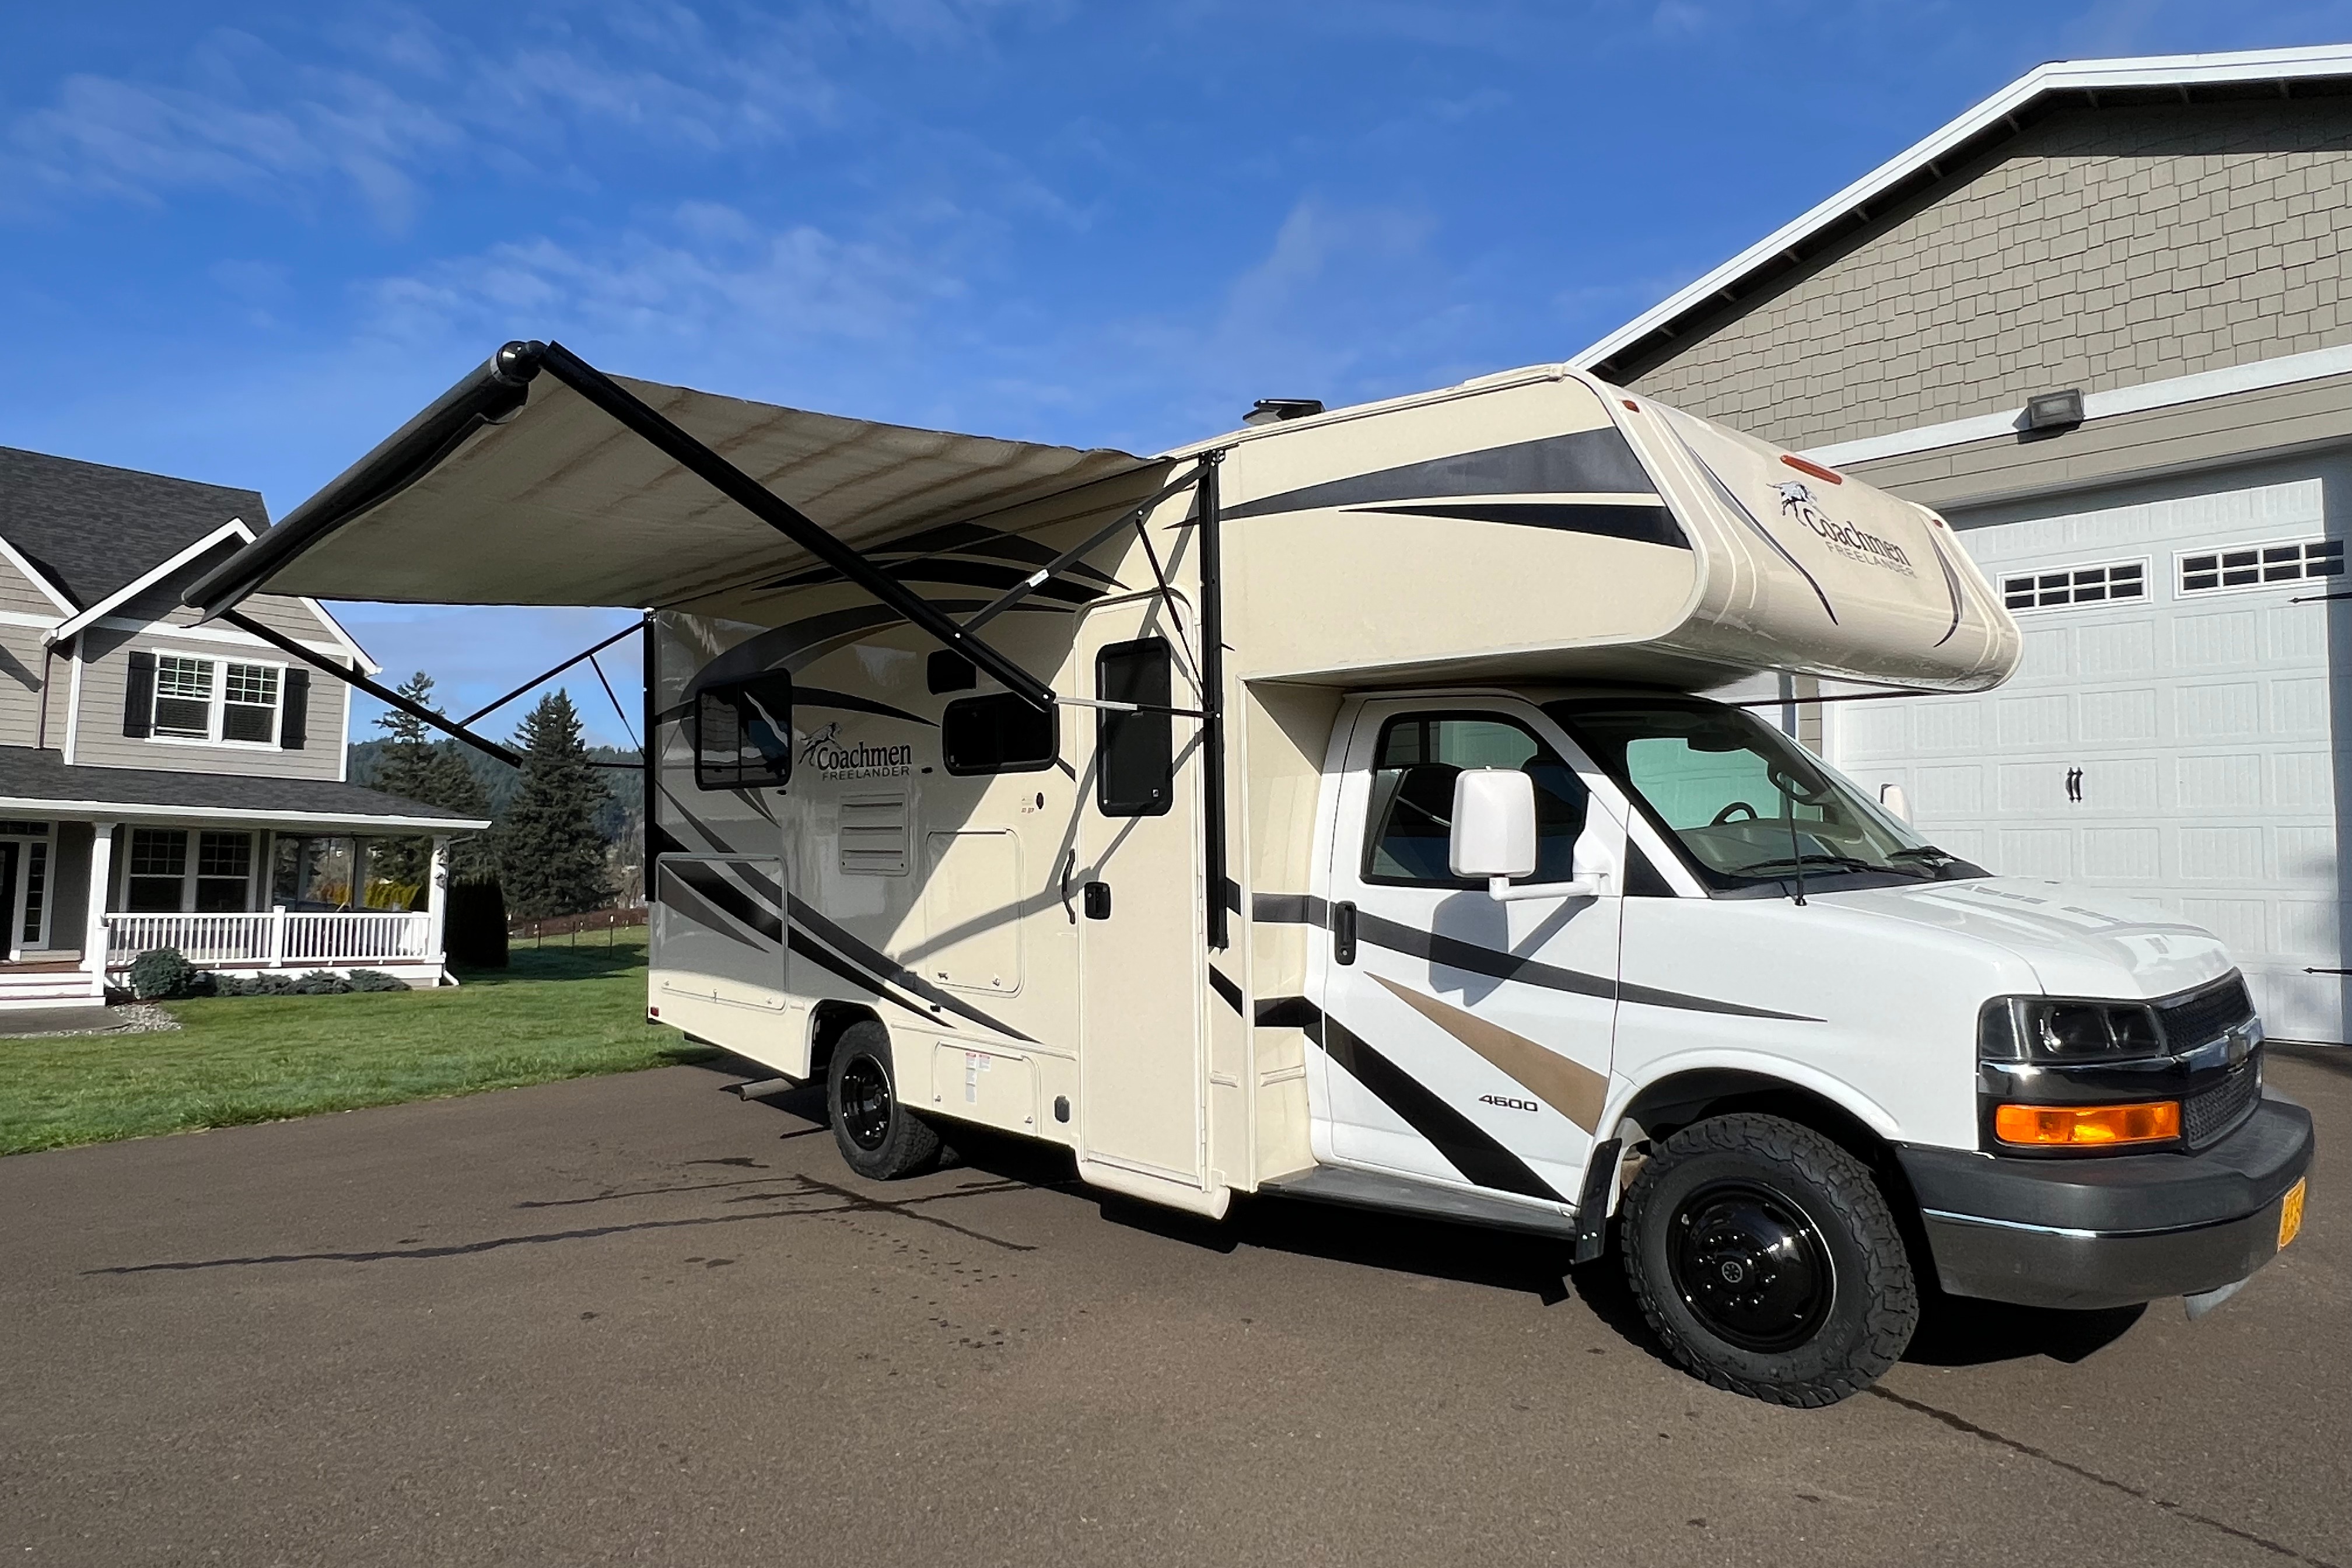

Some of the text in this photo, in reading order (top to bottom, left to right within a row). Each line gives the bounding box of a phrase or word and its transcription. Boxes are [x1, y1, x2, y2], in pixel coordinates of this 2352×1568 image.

[1803, 508, 1911, 566] Coachmen
[1825, 541, 1917, 579] FREELANDER
[818, 741, 912, 770] Coachmen
[822, 766, 910, 780] FREELANDER
